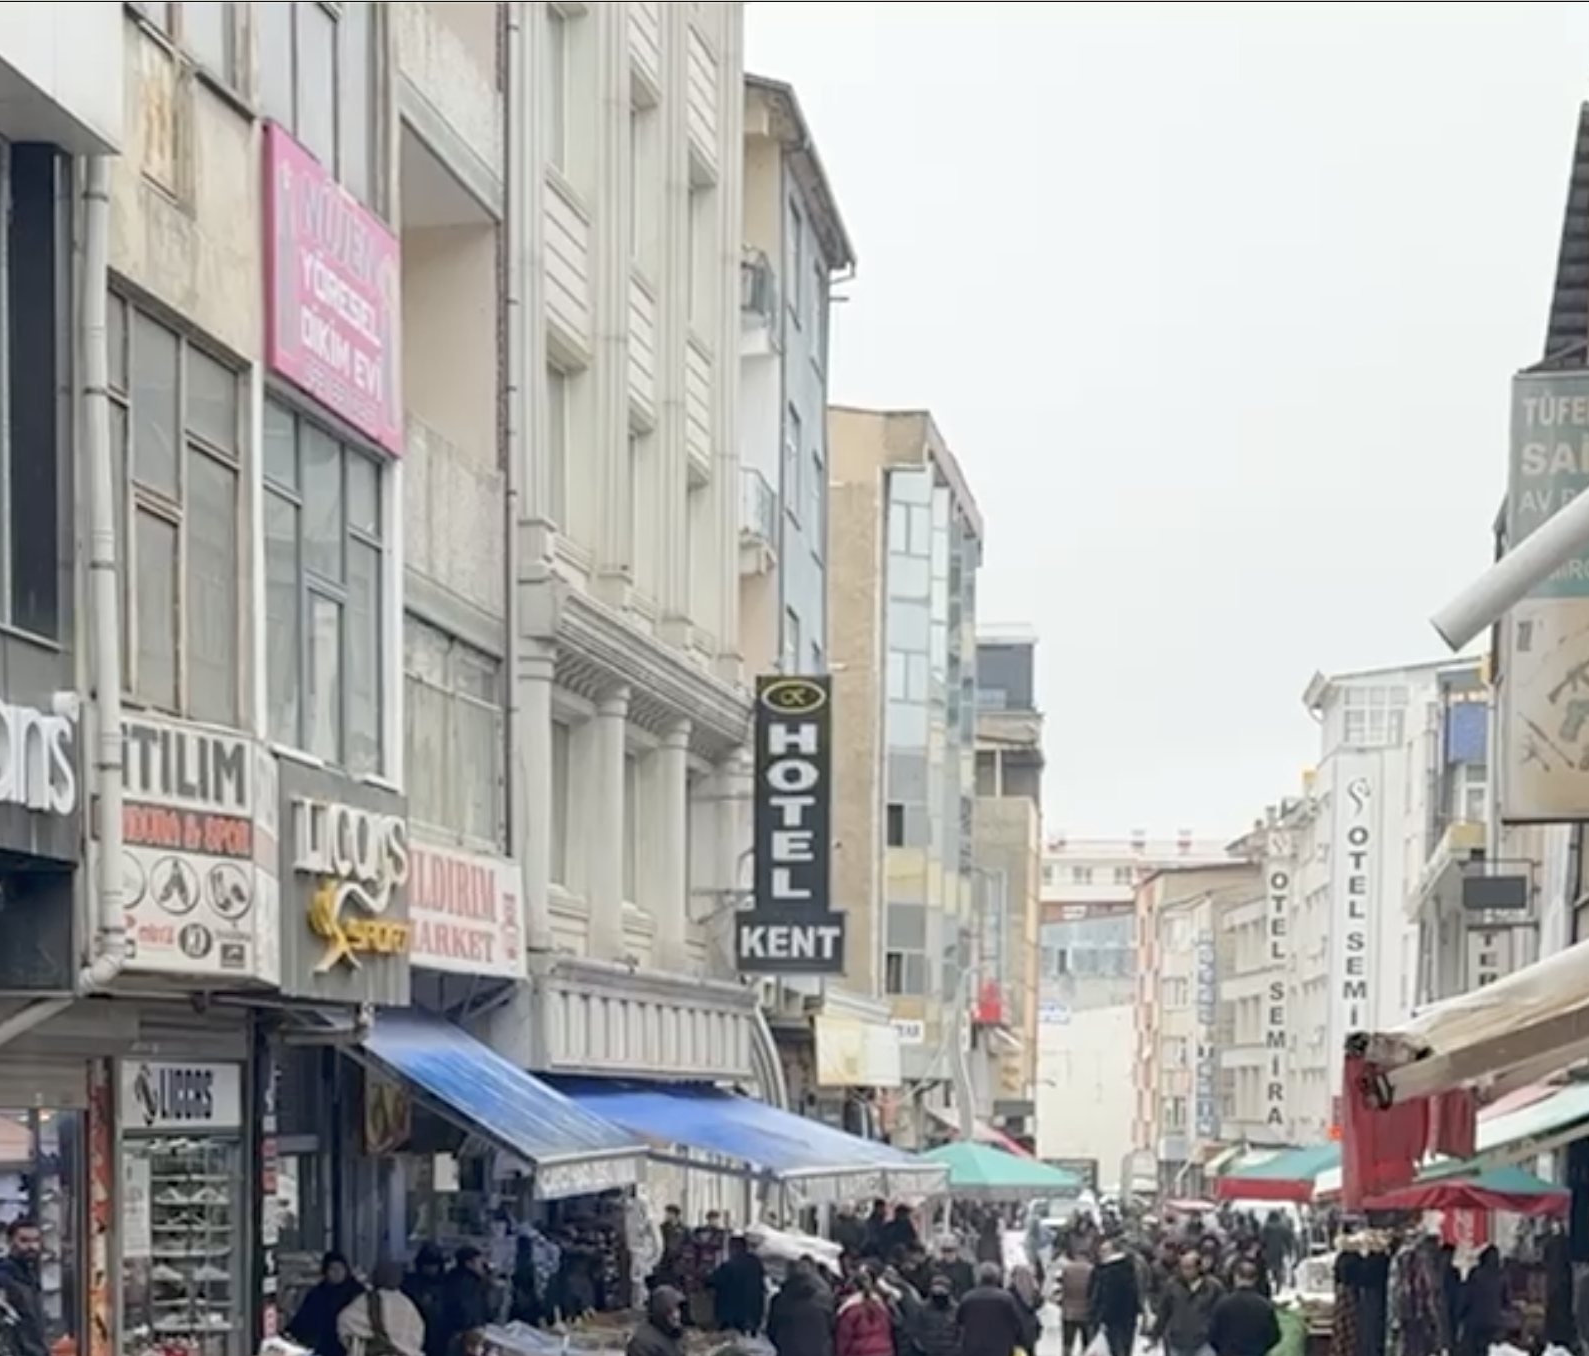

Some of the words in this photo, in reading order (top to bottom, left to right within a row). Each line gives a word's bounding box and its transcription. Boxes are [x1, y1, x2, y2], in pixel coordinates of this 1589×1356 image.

[1519, 489, 1552, 513] AV
[766, 723, 819, 899] HOTEL
[410, 850, 497, 923] ILDIRIM
[1270, 871, 1289, 960] OTEL
[1348, 826, 1370, 919] OTEL
[411, 919, 495, 963] ARKET
[740, 926, 840, 959] KENT
[1343, 931, 1368, 1027] SEMİ
[1265, 980, 1287, 1127] SEMİRA
